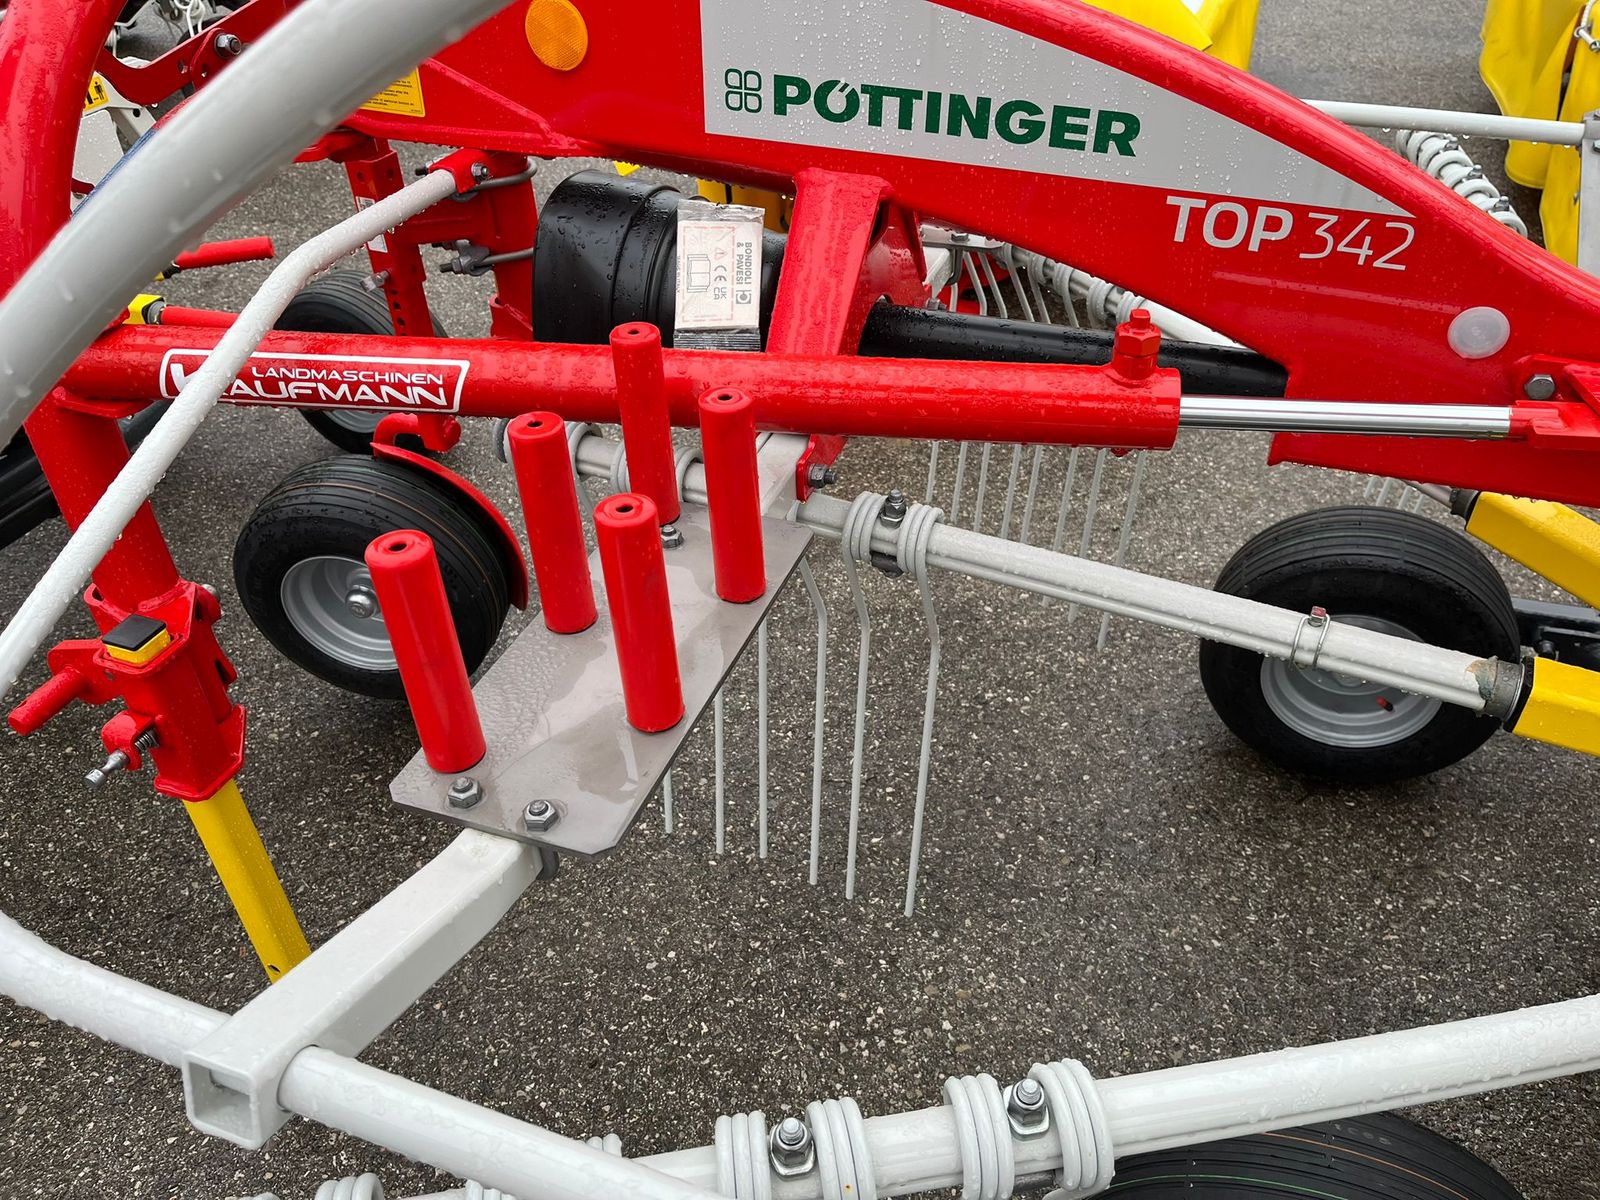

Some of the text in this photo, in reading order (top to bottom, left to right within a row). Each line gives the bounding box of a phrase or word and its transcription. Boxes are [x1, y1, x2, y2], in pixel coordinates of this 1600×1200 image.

[773, 74, 1141, 157] PÖTTINGER
[1166, 195, 1415, 271] TOP 342
[736, 254, 744, 285] PAVESI
[744, 242, 752, 285] BONDIOLI
[252, 366, 443, 385] LANDMASCHINEN
